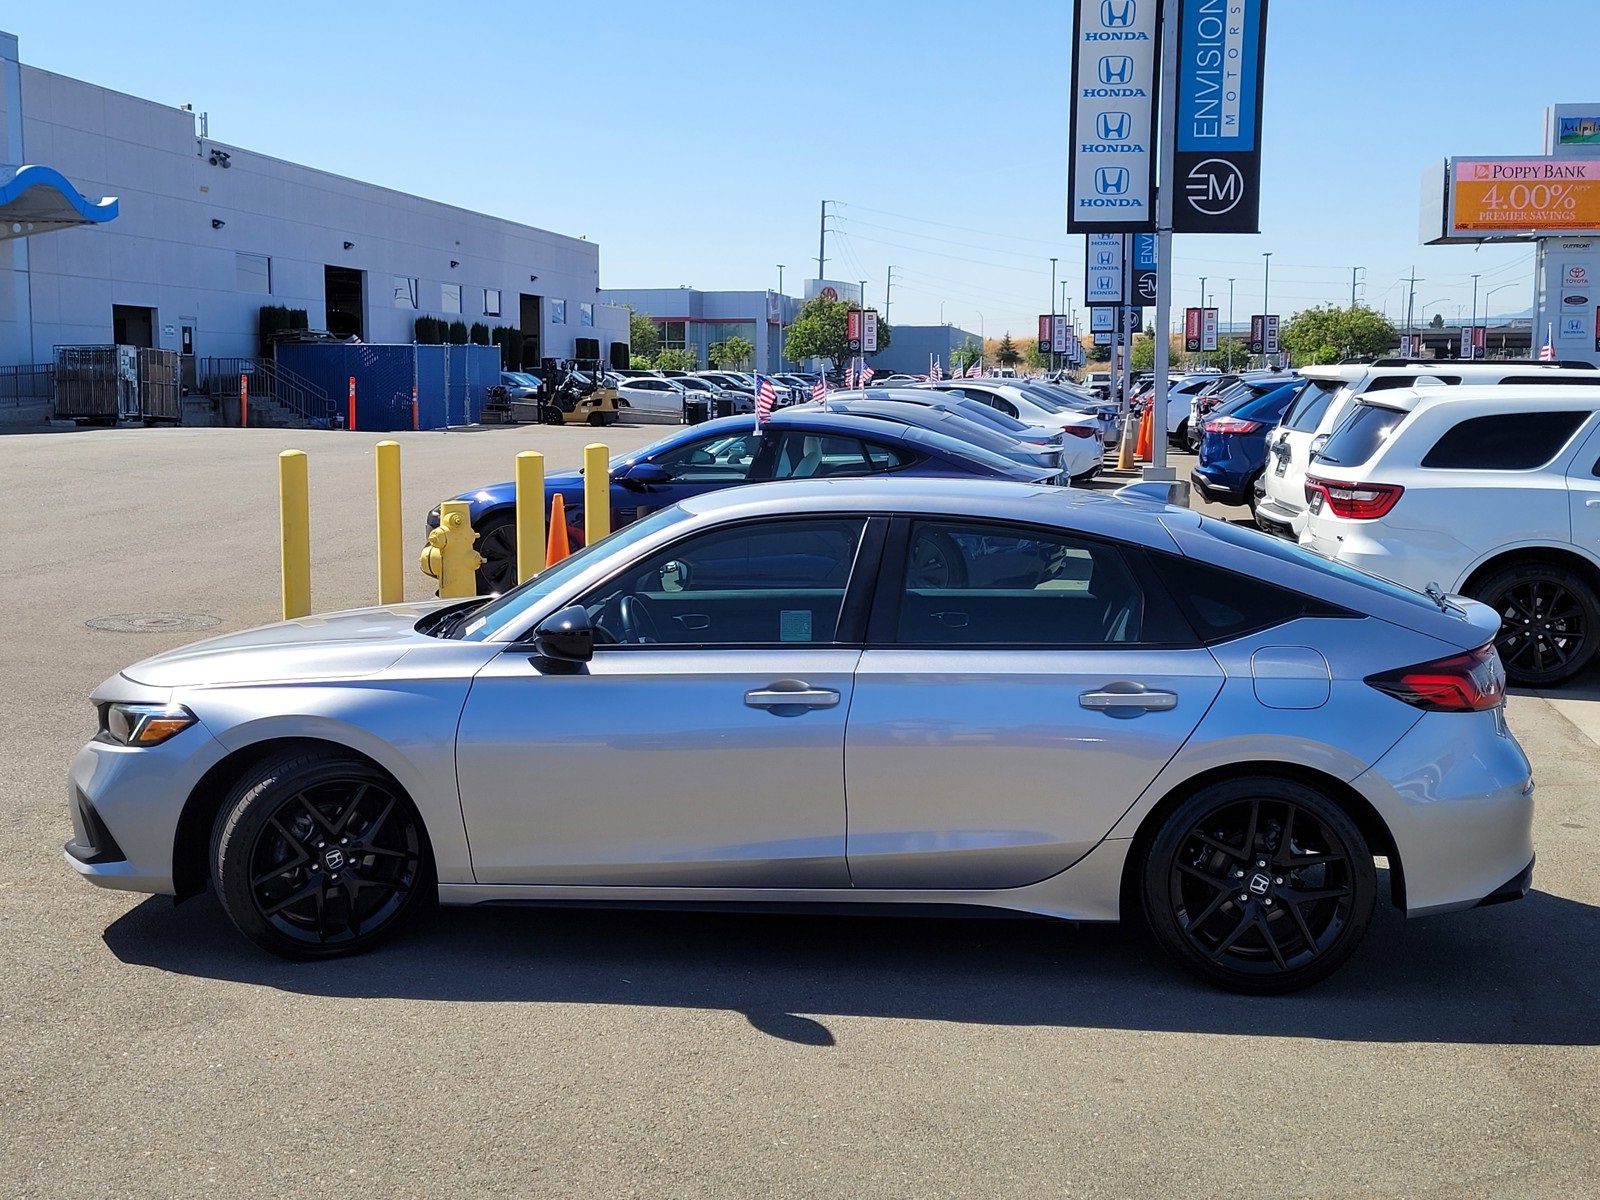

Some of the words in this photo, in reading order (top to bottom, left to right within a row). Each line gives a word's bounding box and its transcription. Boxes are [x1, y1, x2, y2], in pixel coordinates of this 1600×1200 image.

[1085, 31, 1149, 41] HONDA
[1193, 0, 1224, 138] ENVISION
[1225, 6, 1241, 125] MOTORS
[1083, 88, 1147, 97] HONDA
[1081, 144, 1144, 153] HONDA
[1493, 165, 1541, 179] POPPY
[1544, 164, 1586, 178] BANK
[1481, 184, 1576, 210] 4.00%
[1079, 198, 1143, 207] HONDA
[1479, 211, 1529, 221] PREMIER
[1530, 211, 1576, 220] SAVINGS
